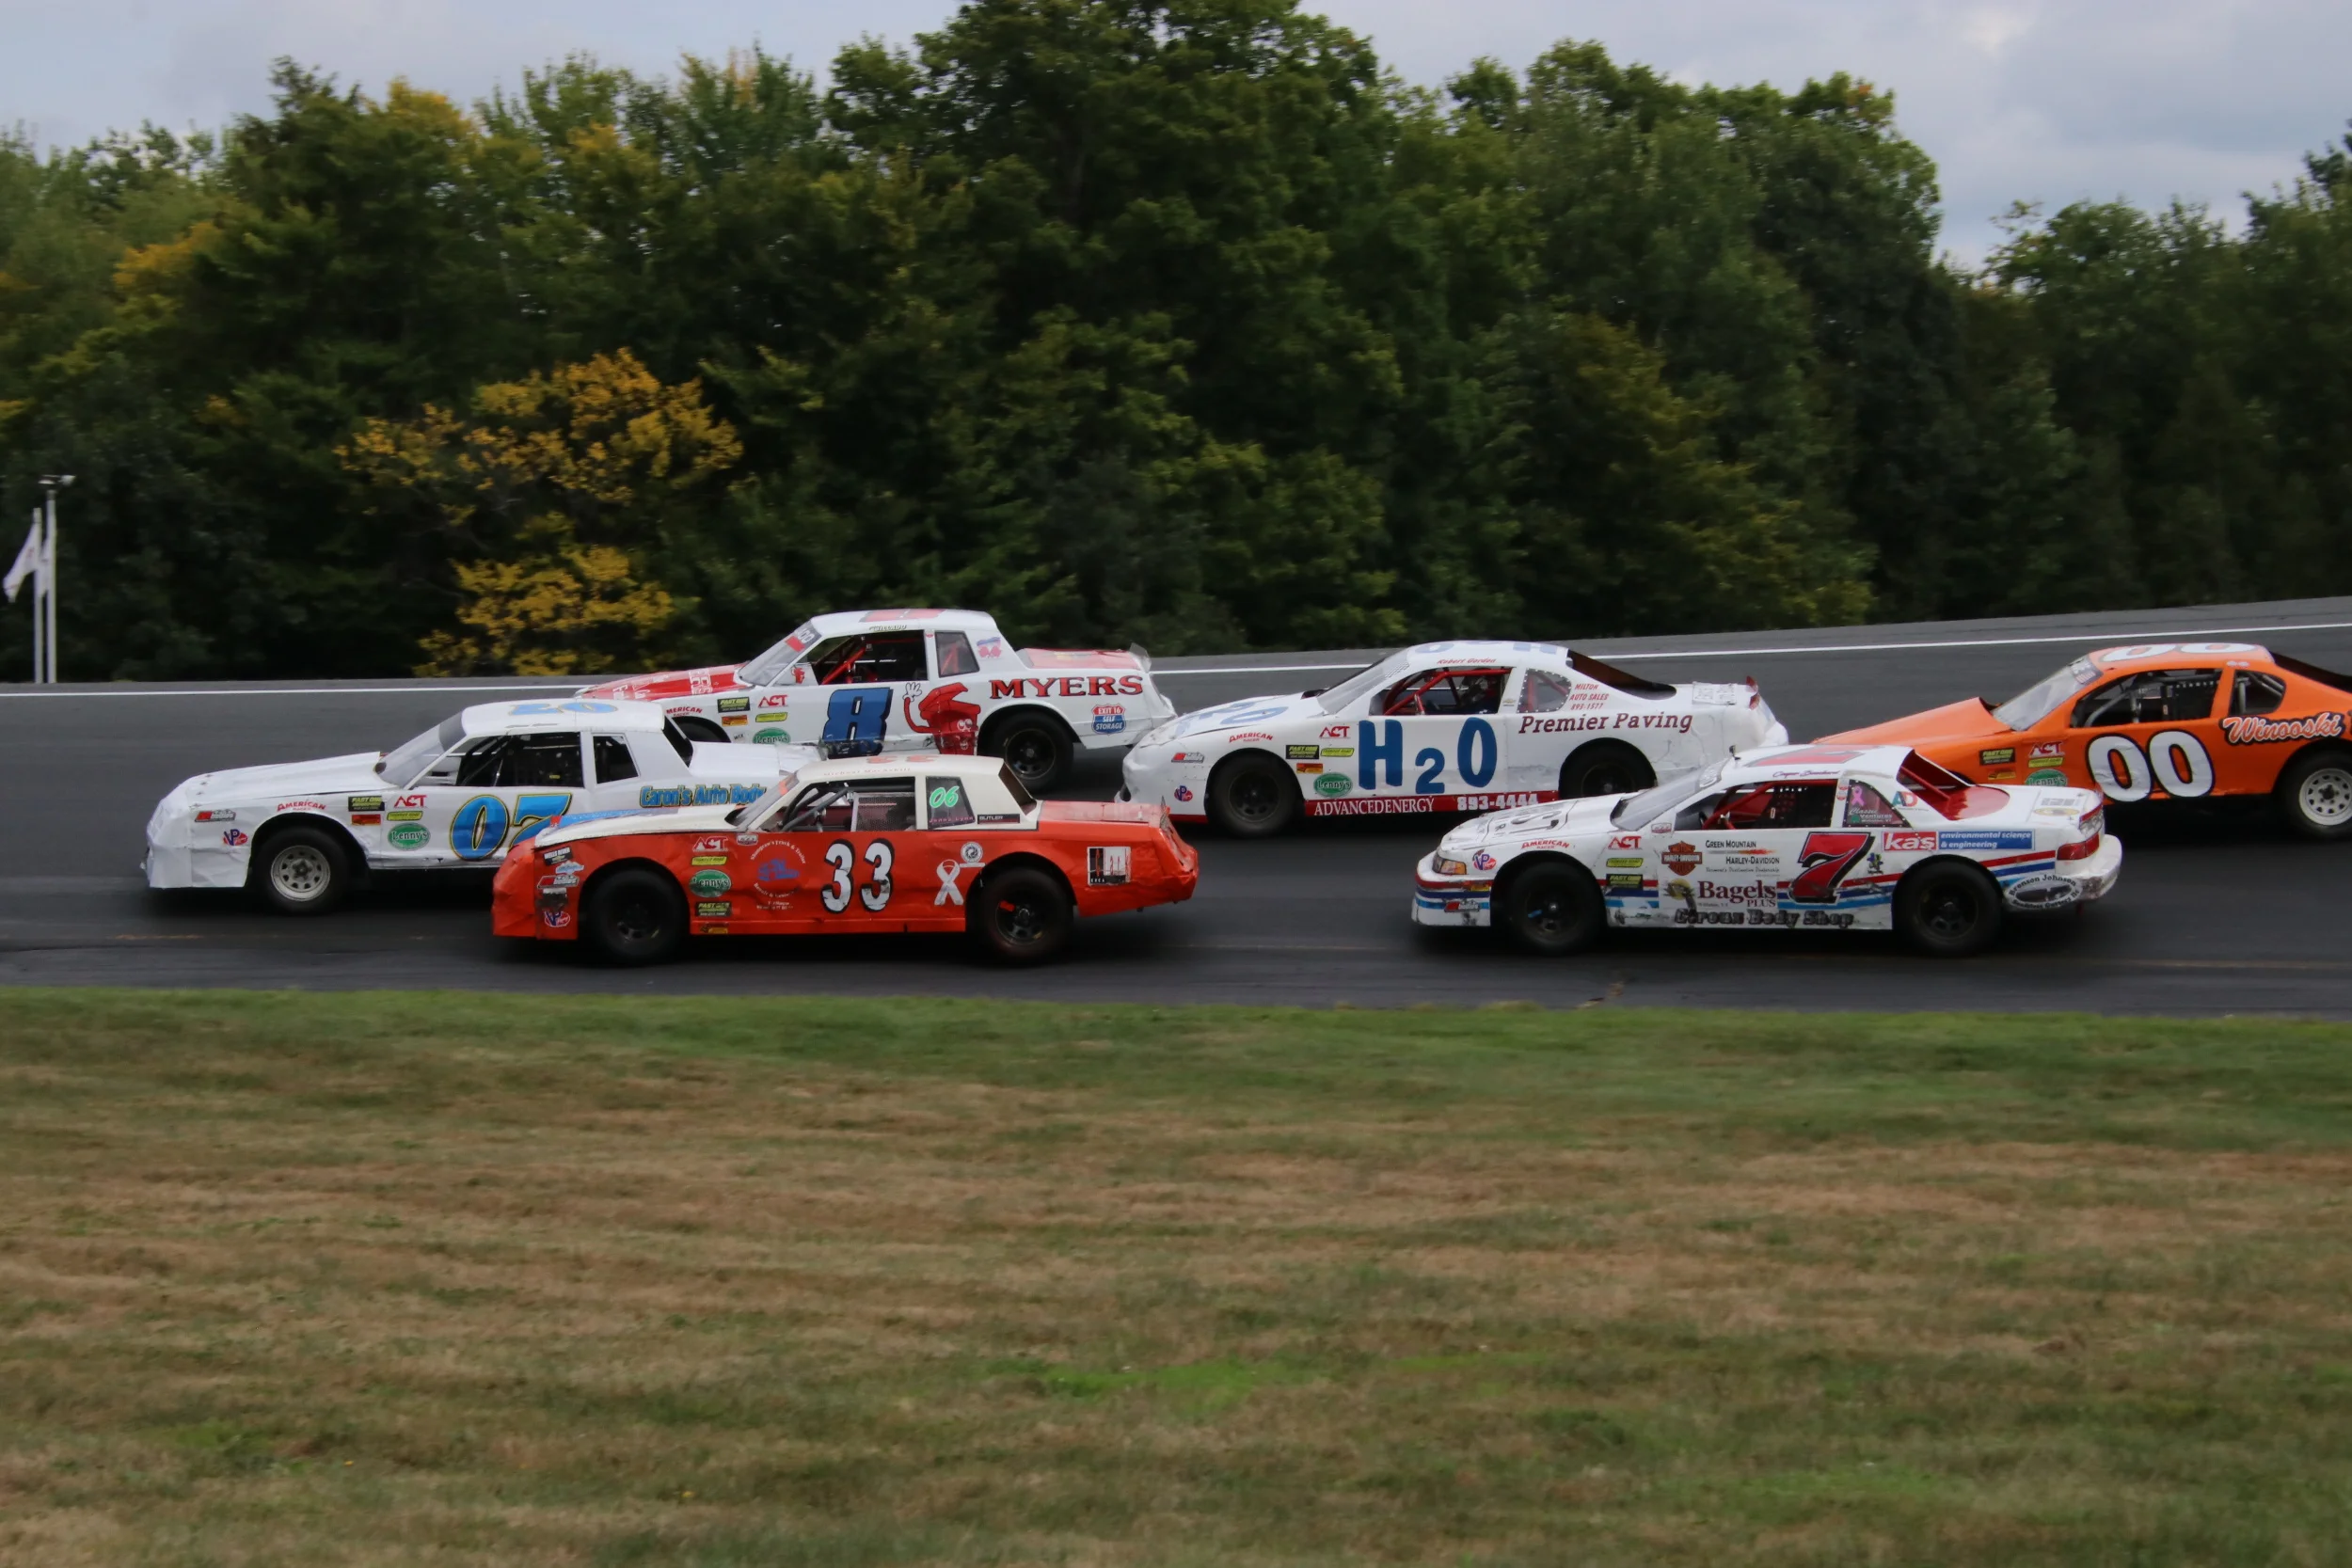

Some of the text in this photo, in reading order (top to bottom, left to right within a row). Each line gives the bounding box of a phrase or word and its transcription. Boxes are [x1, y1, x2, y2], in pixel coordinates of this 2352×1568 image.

[989, 674, 1143, 700] MYERS
[757, 694, 788, 707] ACT
[666, 706, 704, 715] MERICAN
[823, 687, 894, 759] 8
[1095, 721, 1124, 731] STORAGE
[1518, 711, 1693, 735] Premier Paving
[2219, 711, 2344, 745] Winooski
[1229, 732, 1273, 743] AMERICAN
[1318, 725, 1351, 738] ACT
[2028, 740, 2062, 756] ACT
[2087, 728, 2217, 803] 00
[1317, 780, 1351, 791] Lenny's
[393, 794, 428, 808] ACT
[640, 784, 693, 808] Caron's
[693, 784, 729, 806] Auto
[929, 785, 960, 808] 06
[1456, 793, 1539, 812] 893-4444
[1891, 791, 1918, 807] AD
[277, 800, 327, 812] AMERICAN
[1849, 807, 1879, 816] Classic
[449, 792, 572, 862] 07
[223, 829, 240, 846] VP
[391, 830, 428, 843] Lenny's
[692, 835, 729, 852] ACT
[1520, 839, 1569, 849] AMERICAN
[1607, 835, 1643, 849] ACT
[1705, 840, 1756, 848] GREEN MOUNTAIN
[1948, 841, 1998, 849] engineering
[1475, 853, 1490, 871] VP
[1725, 856, 1780, 864] HARLEY-DAVIDSON
[1797, 832, 1875, 904] 7
[820, 837, 896, 914] 33
[2042, 874, 2076, 886] Johnson
[1696, 879, 1777, 905] Bagels
[1746, 898, 1776, 908] PLUS
[1802, 910, 1853, 928] Shop
